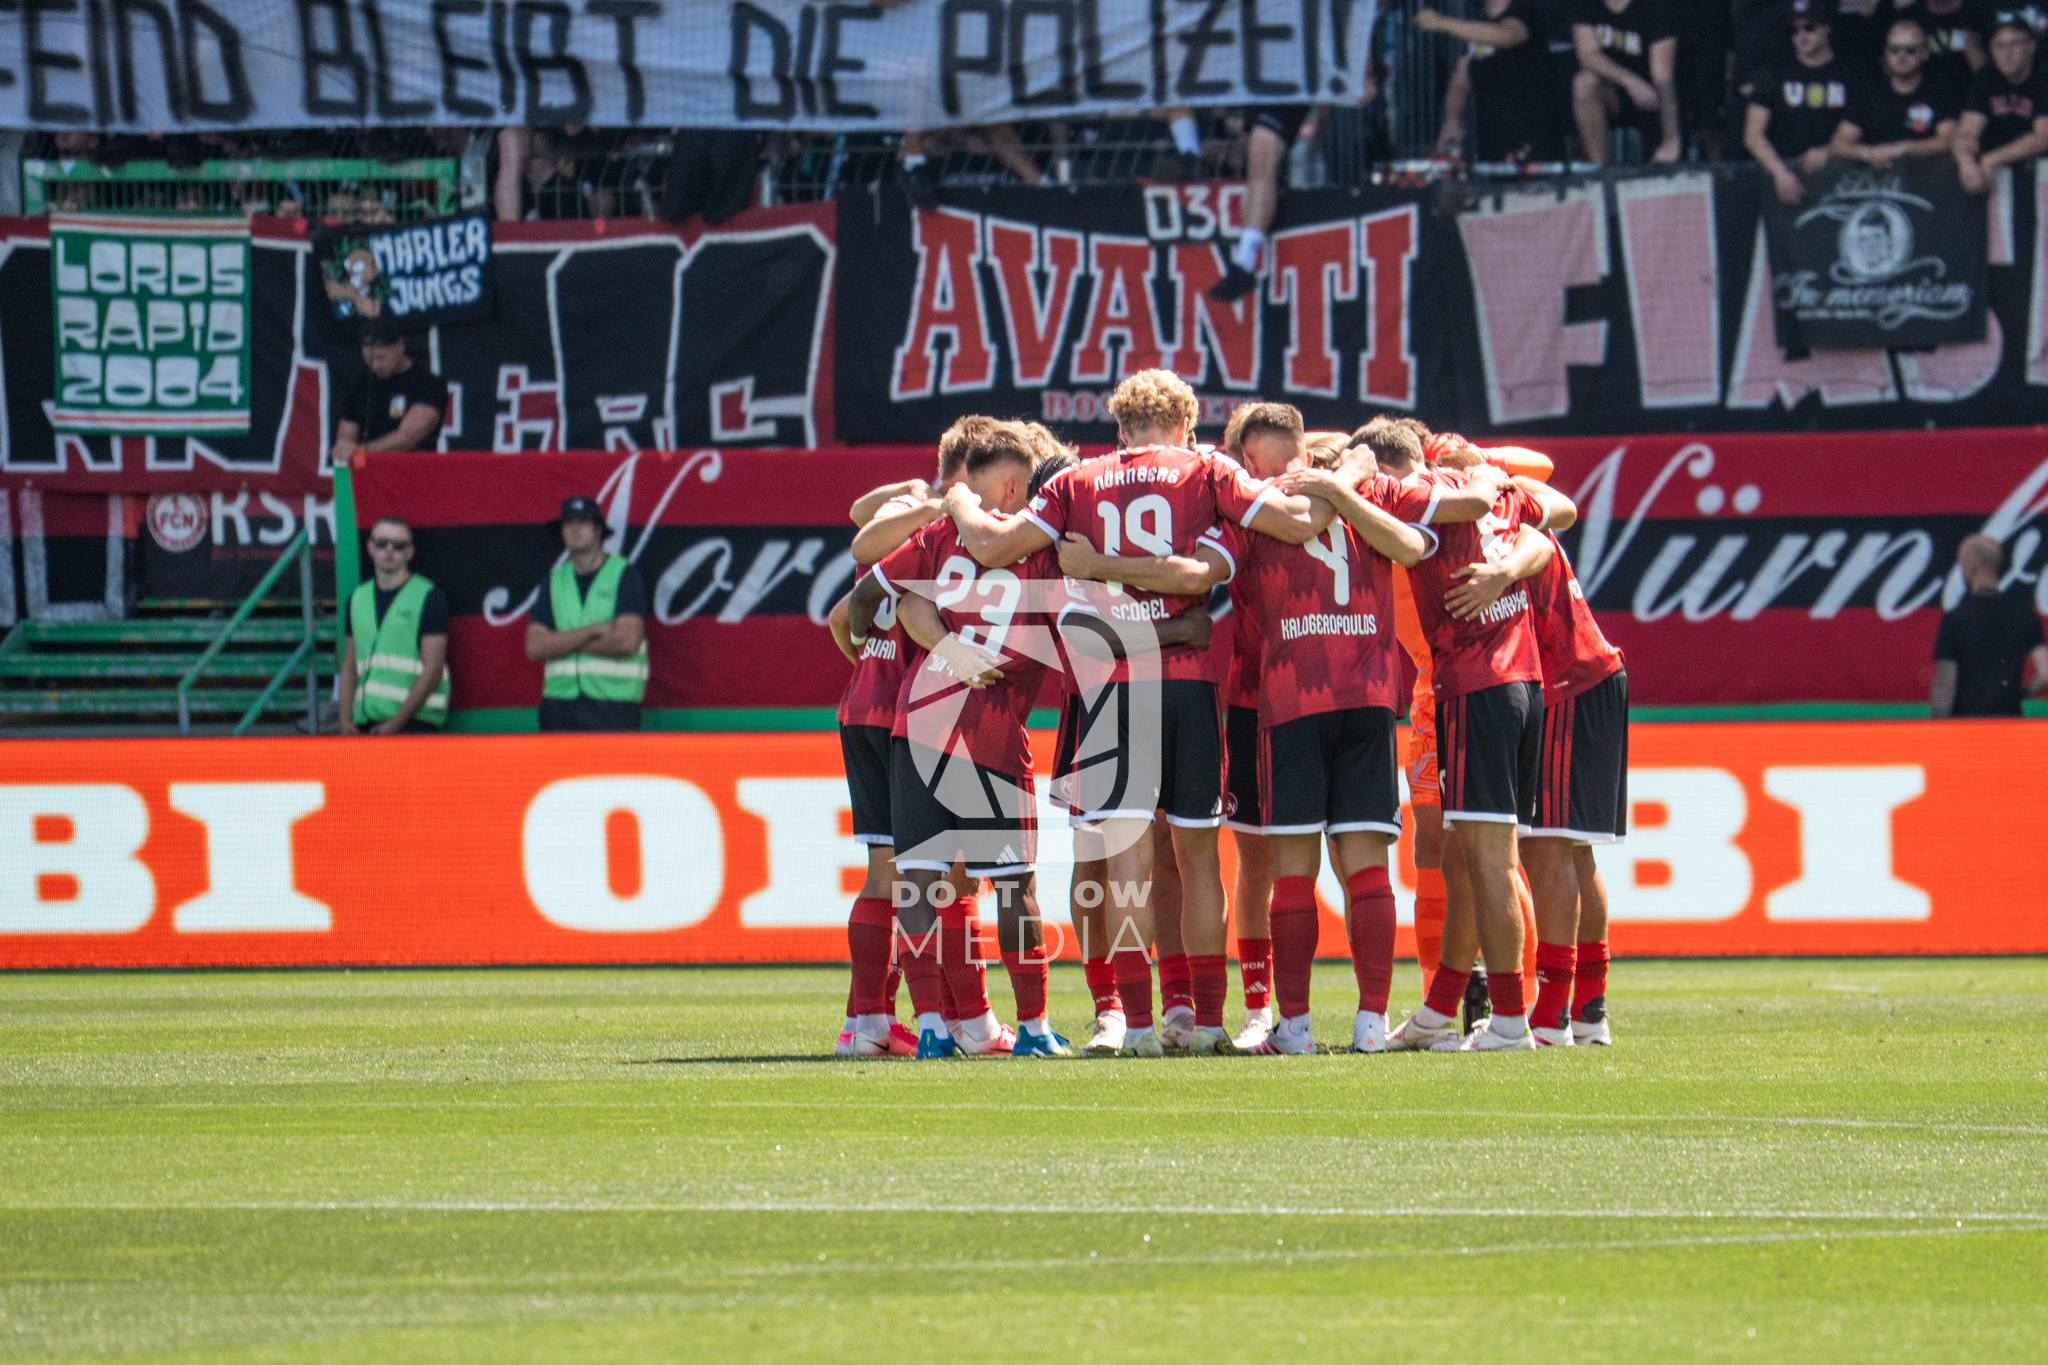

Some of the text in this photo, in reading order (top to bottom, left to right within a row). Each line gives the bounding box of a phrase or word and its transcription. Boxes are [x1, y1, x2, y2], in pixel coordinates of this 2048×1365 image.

[0, 0, 1354, 123] EIND BLEIBT DIE POLIZEI!
[57, 238, 244, 295] LORDS
[370, 217, 489, 277] MARLER
[58, 301, 244, 352] RAPID
[389, 266, 482, 316] JUNGS
[891, 202, 1417, 411] AVANTI
[60, 355, 244, 406] 2004
[1303, 514, 1350, 606] 4
[1562, 442, 2048, 624] Nürnb
[935, 554, 1022, 658] 23
